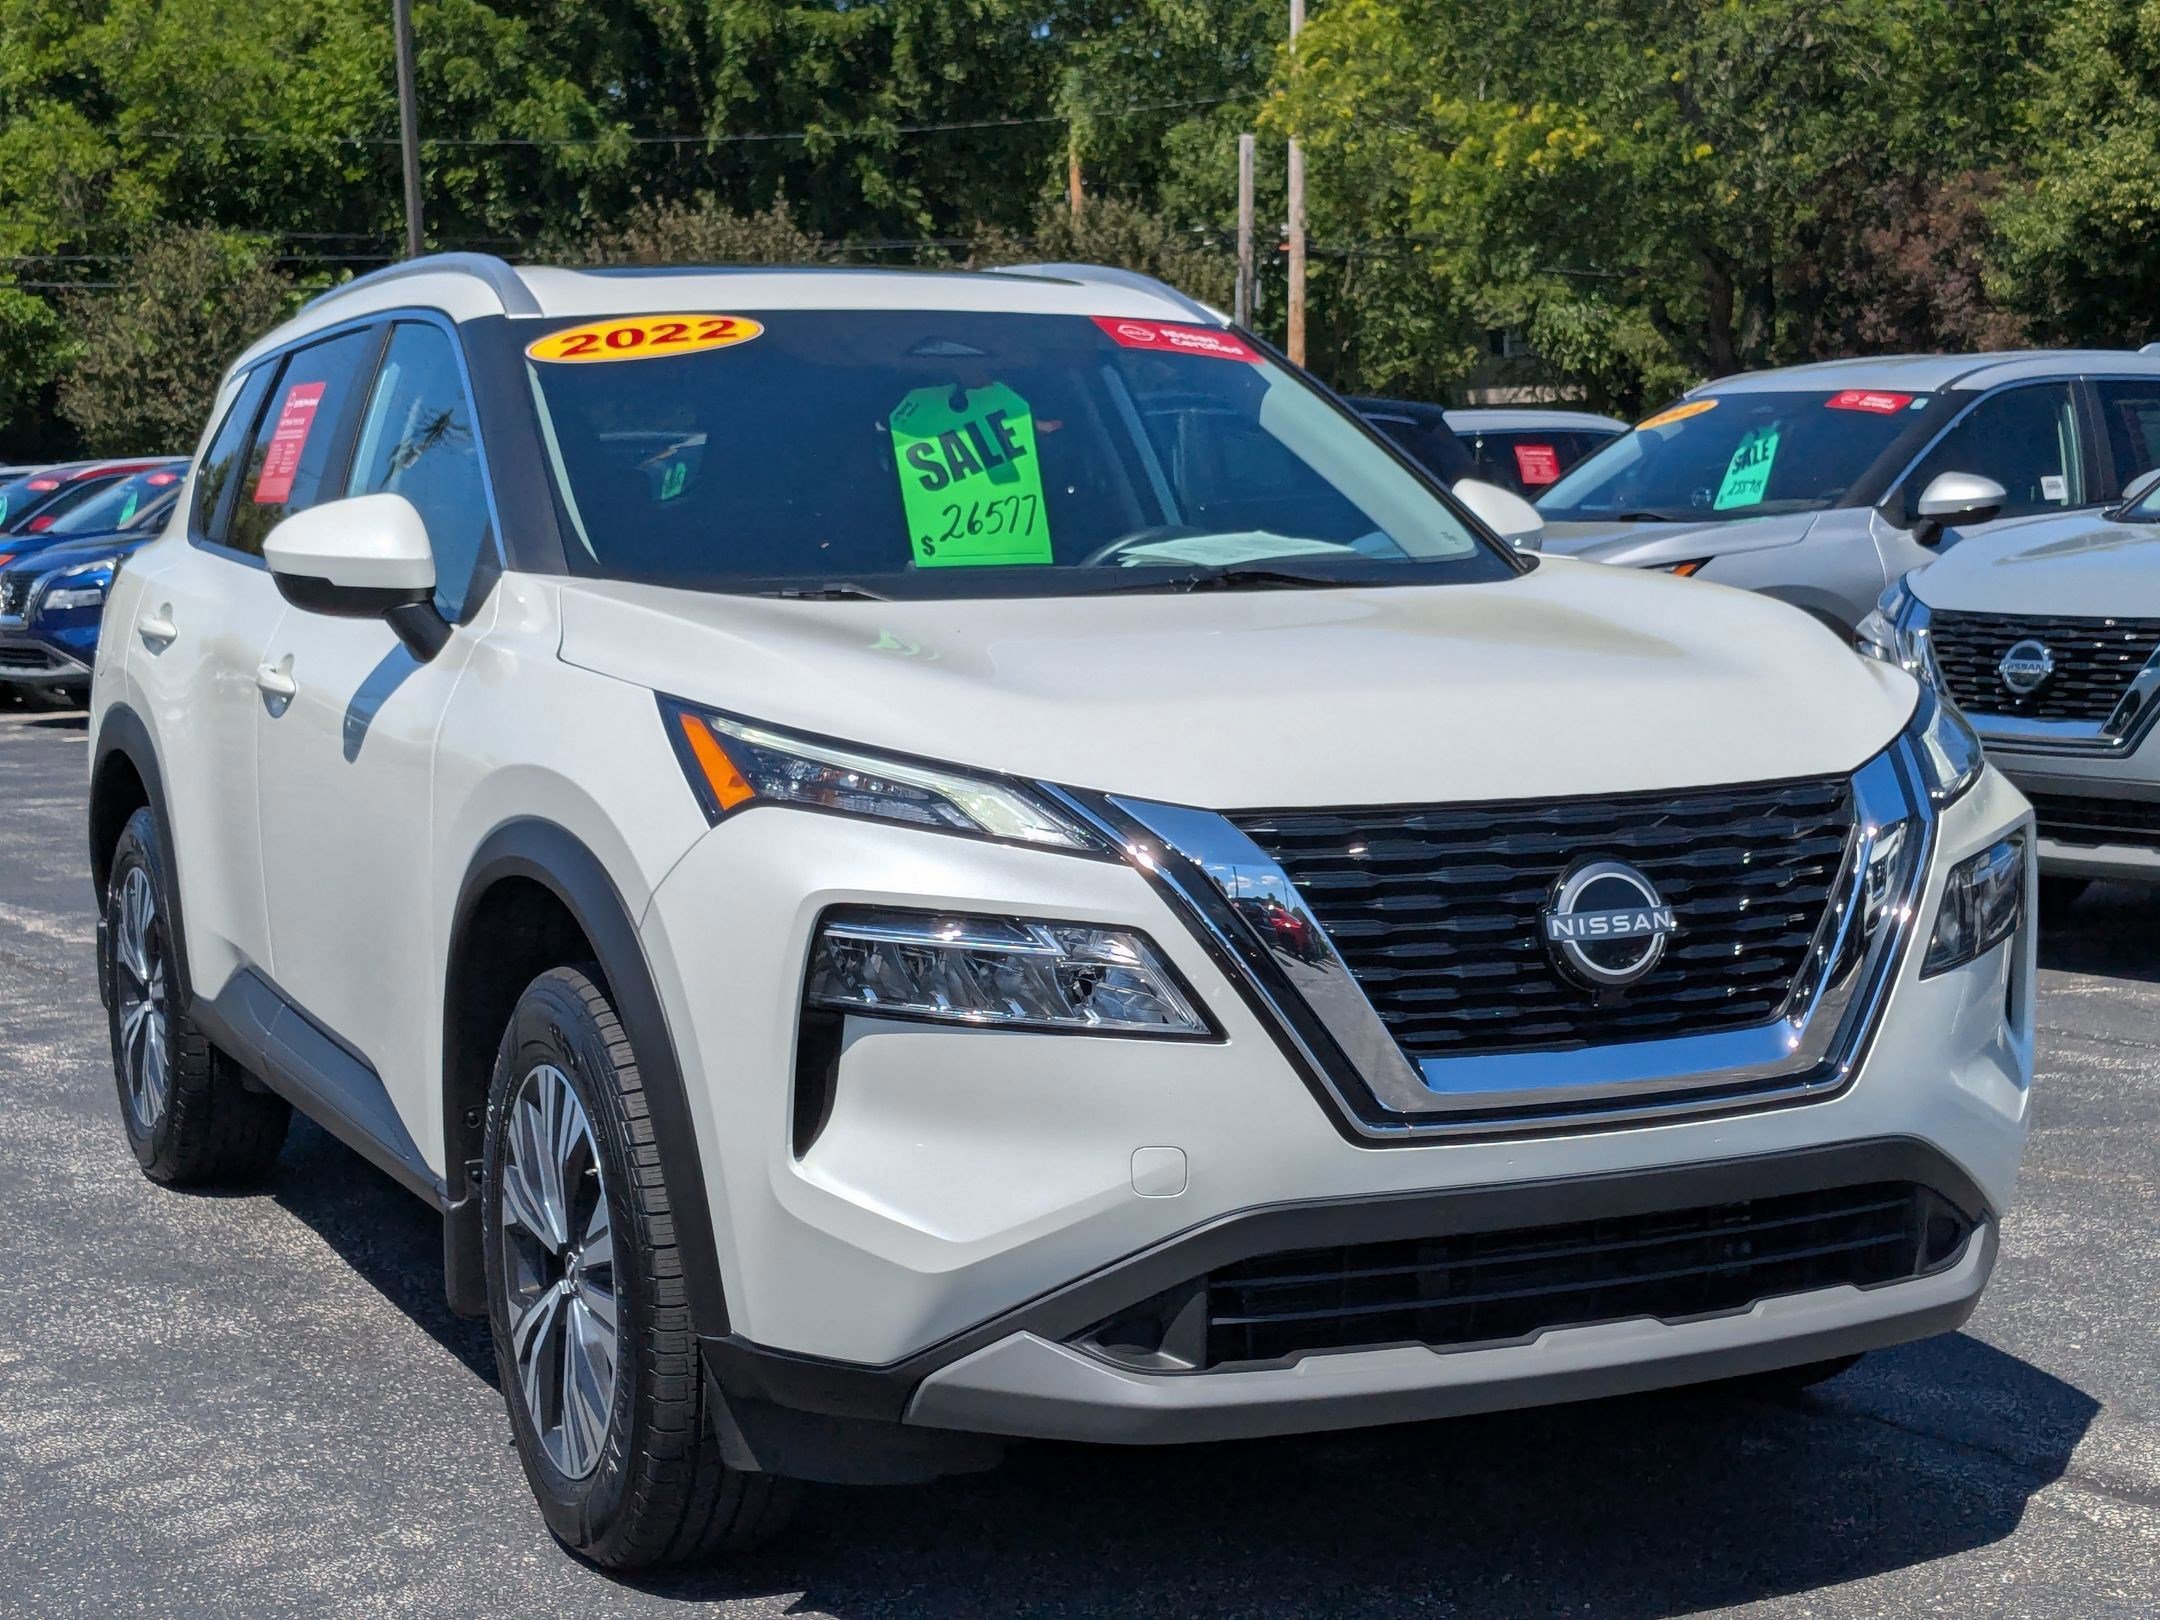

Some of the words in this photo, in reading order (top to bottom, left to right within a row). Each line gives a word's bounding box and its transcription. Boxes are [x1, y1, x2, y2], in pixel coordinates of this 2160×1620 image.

[560, 320, 738, 357] 2022
[906, 409, 1028, 492] SALE
[1732, 440, 1770, 475] SALE
[939, 494, 1038, 543] 26577
[1551, 910, 1670, 937] NISSAN
